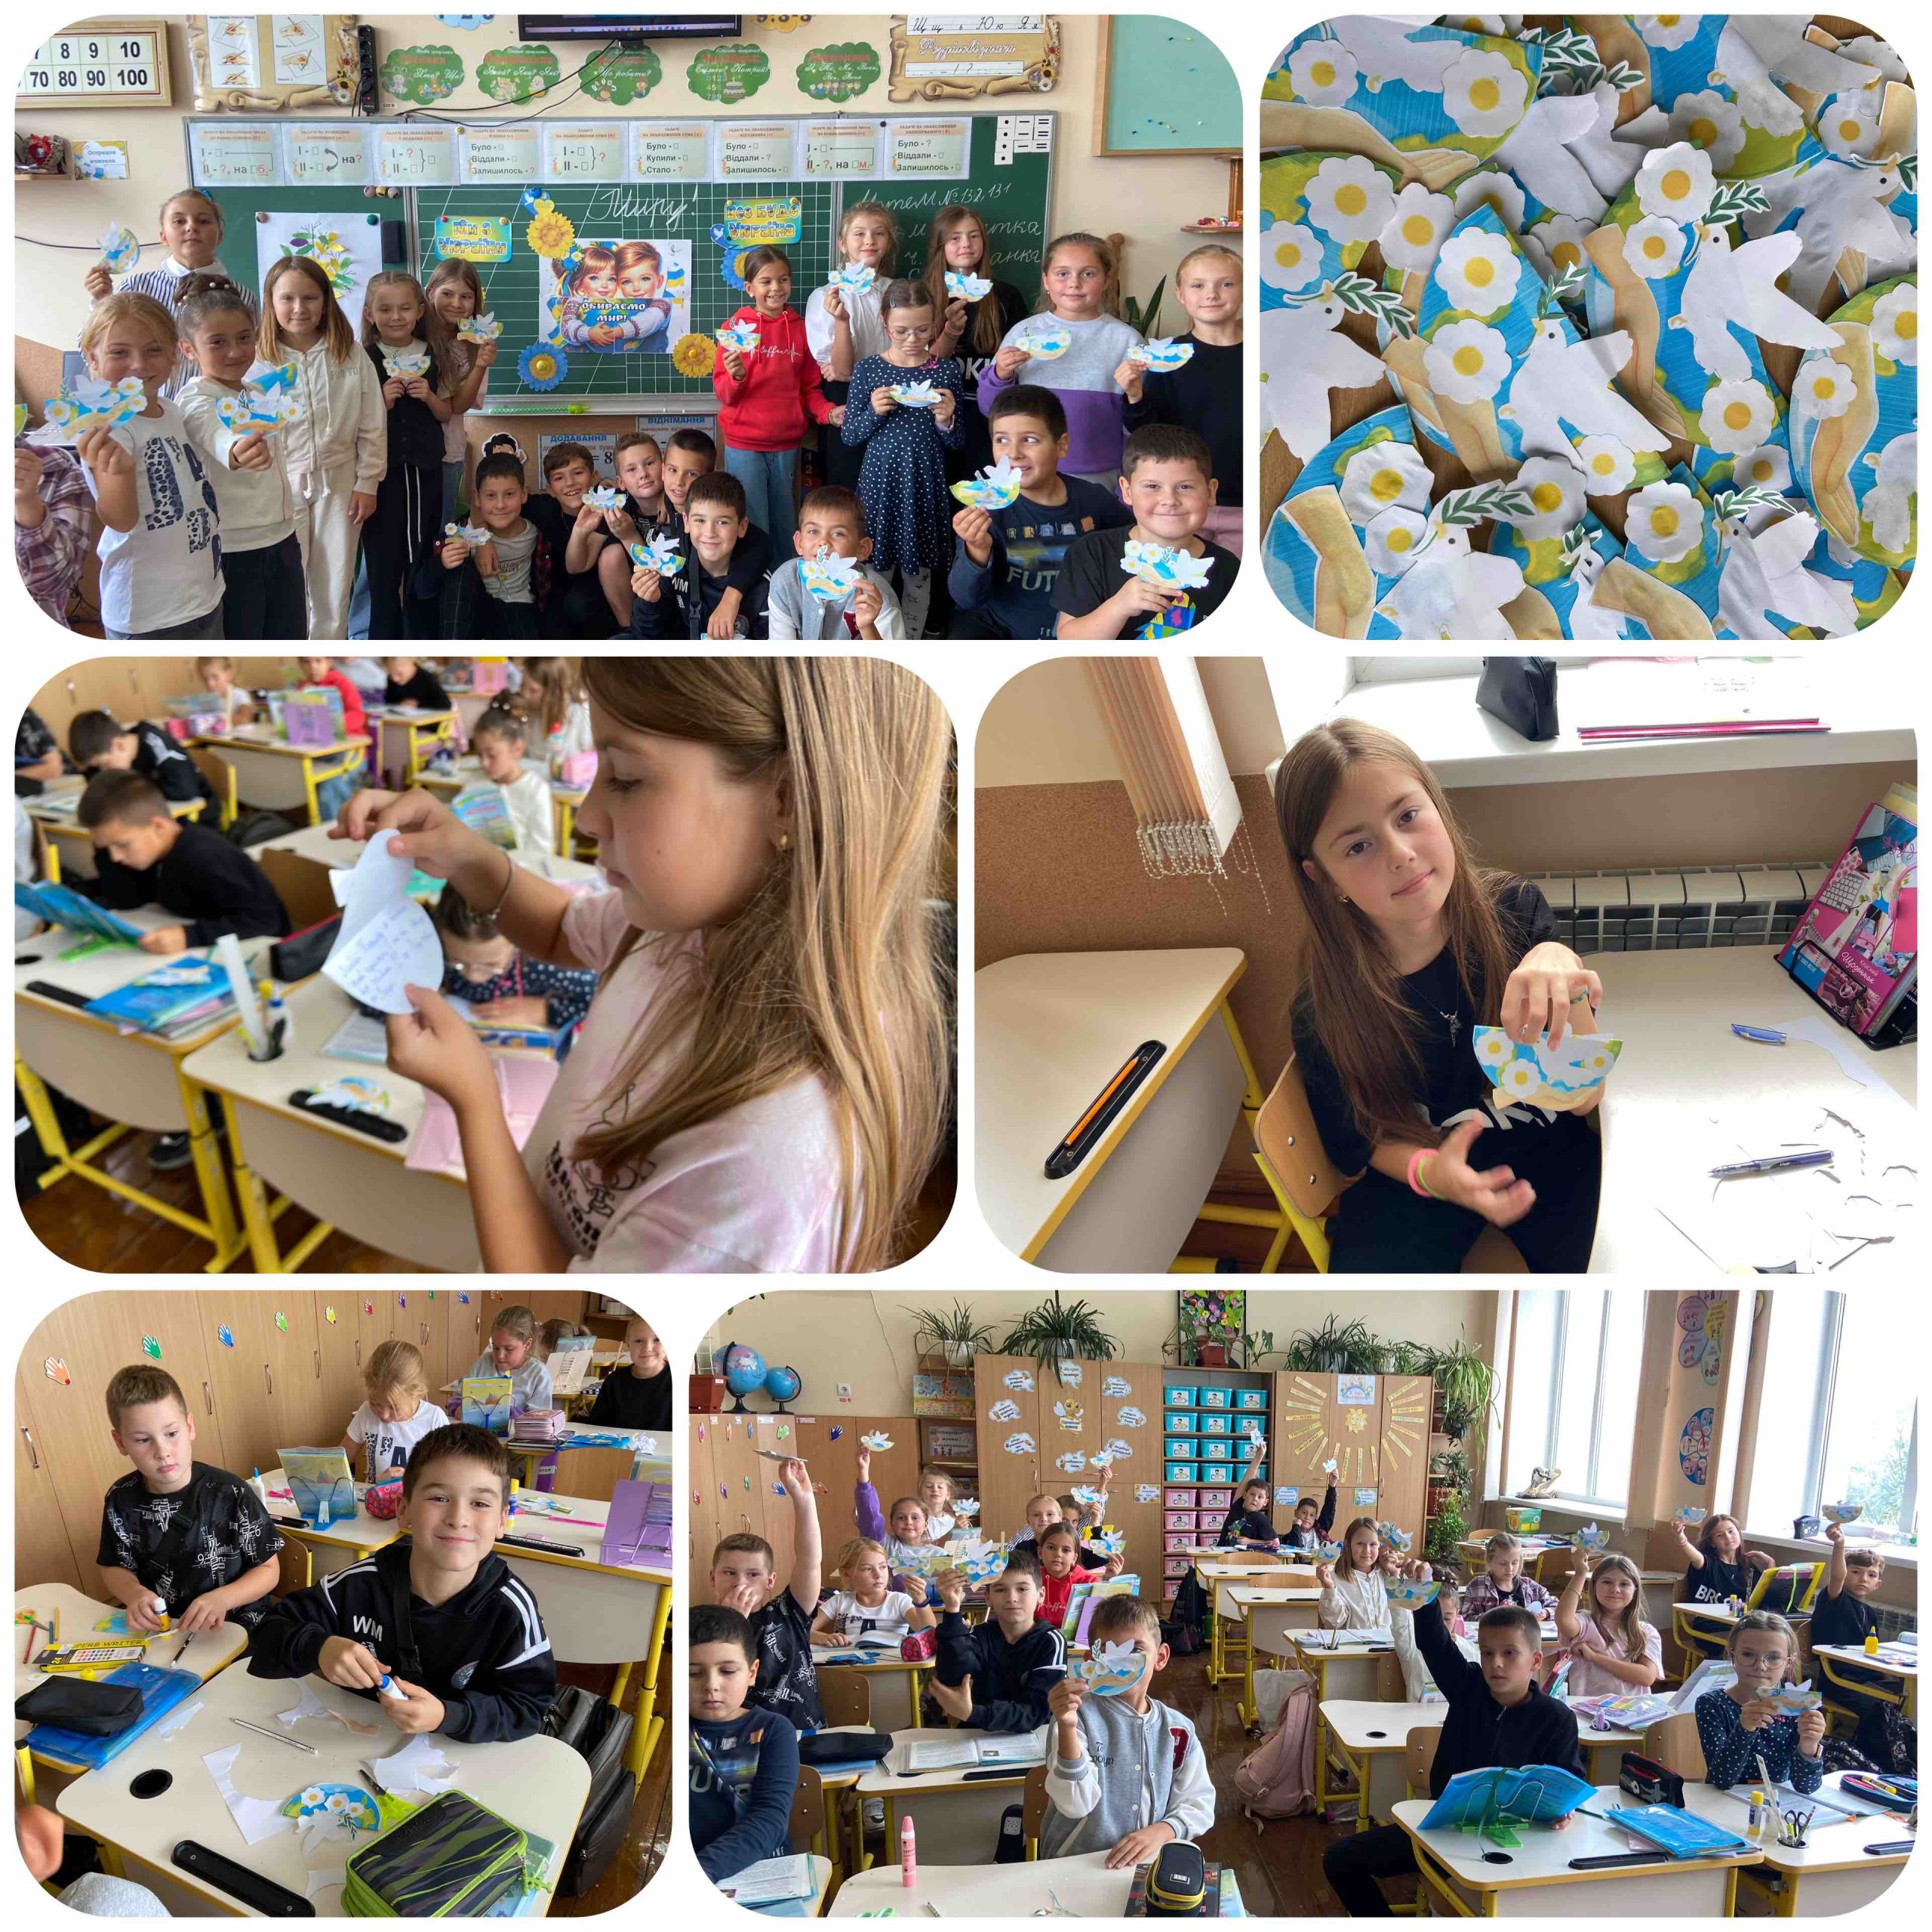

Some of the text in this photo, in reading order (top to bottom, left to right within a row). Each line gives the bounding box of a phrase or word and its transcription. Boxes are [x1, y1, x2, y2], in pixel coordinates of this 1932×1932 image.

[60, 42, 140, 59] 8 9 10
[30, 69, 148, 88] 70 80 90 100
[471, 143, 491, 152] Було
[646, 143, 666, 151] Було
[726, 143, 746, 151] Було
[898, 140, 919, 149] Було
[472, 155, 505, 164] Віддали
[726, 154, 759, 163] Віддали
[897, 152, 931, 160] Віддали
[726, 166, 777, 174] Залишилось
[648, 416, 706, 425] ВІДНІМАННЯ
[550, 434, 608, 444] ДОДАВАННЯ
[604, 451, 613, 464] 8
[1841, 951, 1876, 985] Щоденник
[1859, 959, 1879, 977] Класний
[352, 1614, 383, 1641] WM
[103, 1638, 143, 1647] WRITER
